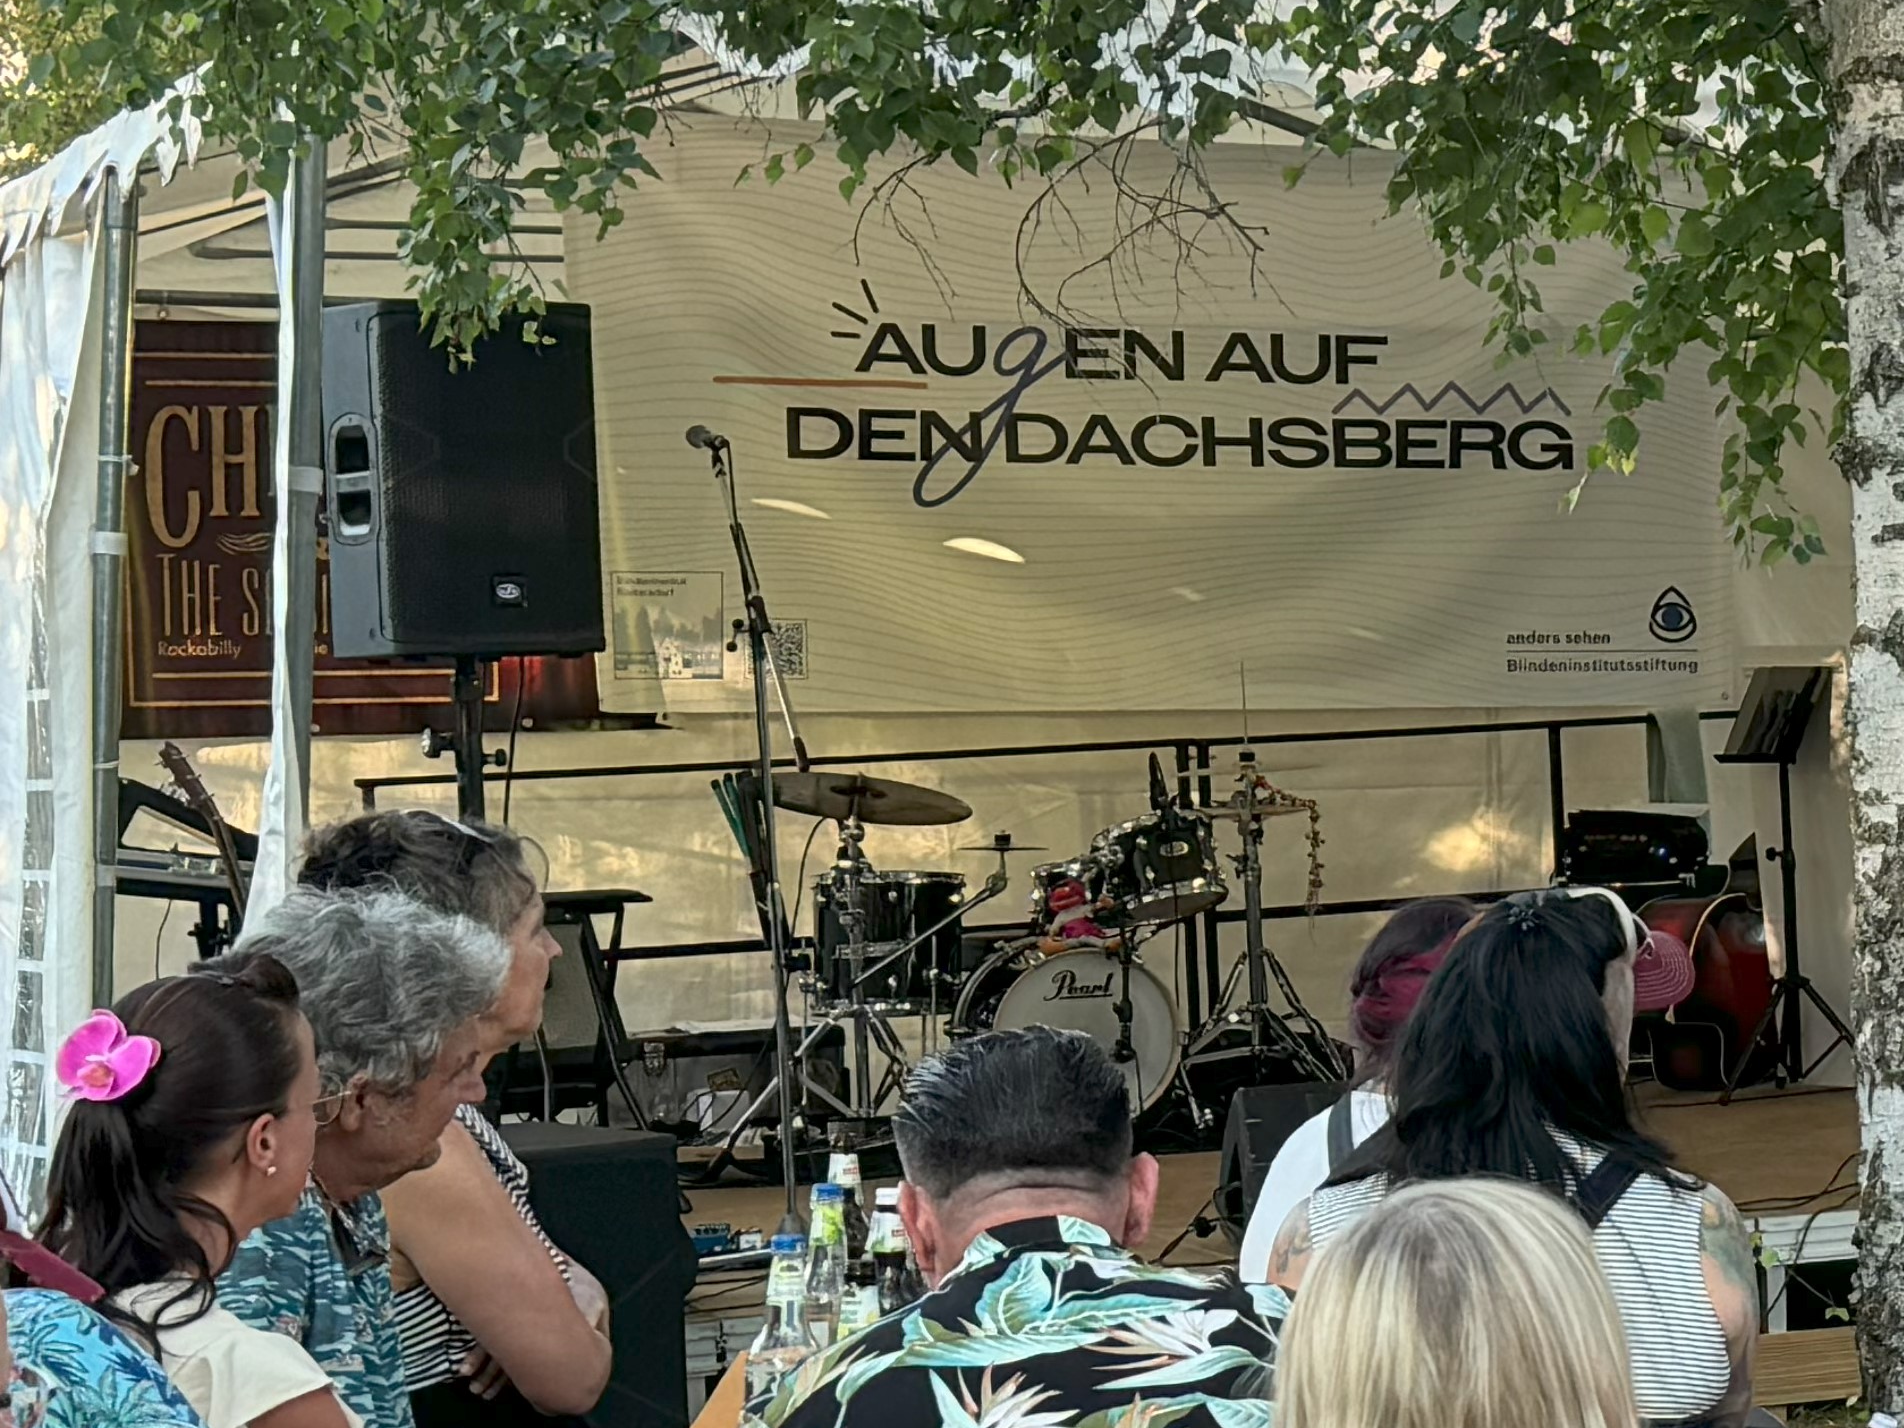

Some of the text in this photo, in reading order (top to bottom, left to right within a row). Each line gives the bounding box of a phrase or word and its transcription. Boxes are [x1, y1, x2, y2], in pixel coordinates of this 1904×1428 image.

[1204, 332, 1388, 385] AUF
[786, 407, 1574, 471] DEN DACHSBERG
[156, 553, 223, 636] THE
[158, 639, 242, 659] Rockabilly
[1506, 630, 1611, 645] anders sehen
[1507, 658, 1699, 674] Blindeninstitutsstiftung
[1043, 969, 1114, 1001] Pearl
